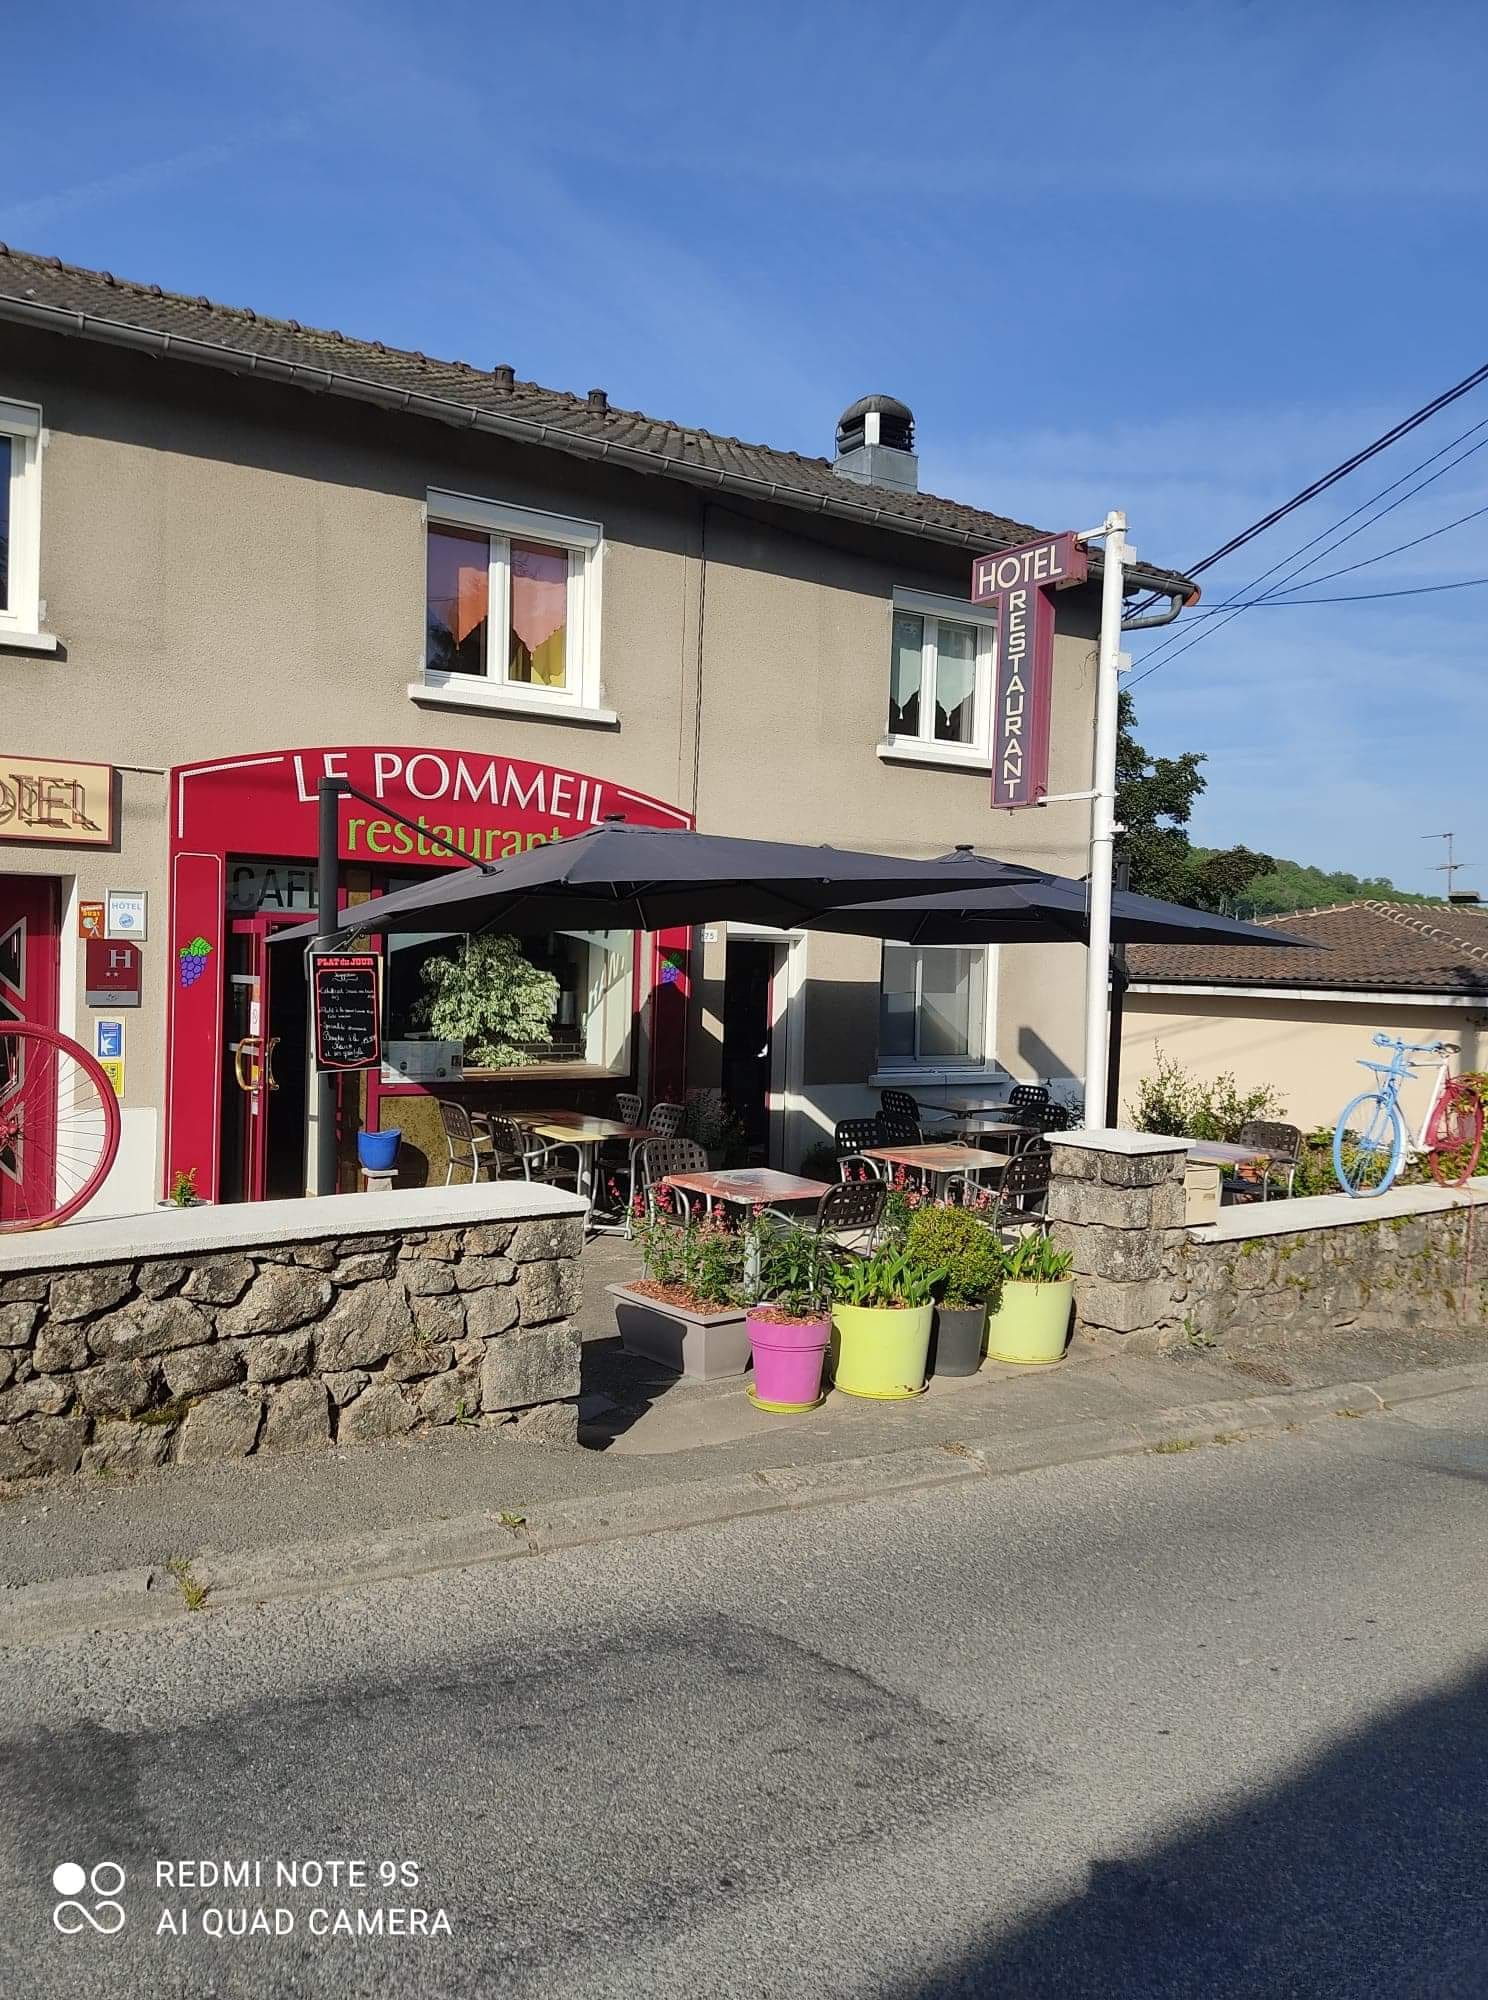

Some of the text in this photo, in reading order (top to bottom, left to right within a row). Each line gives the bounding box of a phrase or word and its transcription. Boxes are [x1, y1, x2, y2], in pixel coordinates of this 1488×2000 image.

[978, 544, 1063, 595] HOTEL
[1003, 589, 1026, 799] RESTAURANT
[293, 752, 605, 826] LE POMMEIL
[109, 949, 133, 969] H
[317, 958, 340, 967] PLAT
[350, 957, 374, 966] JOUR
